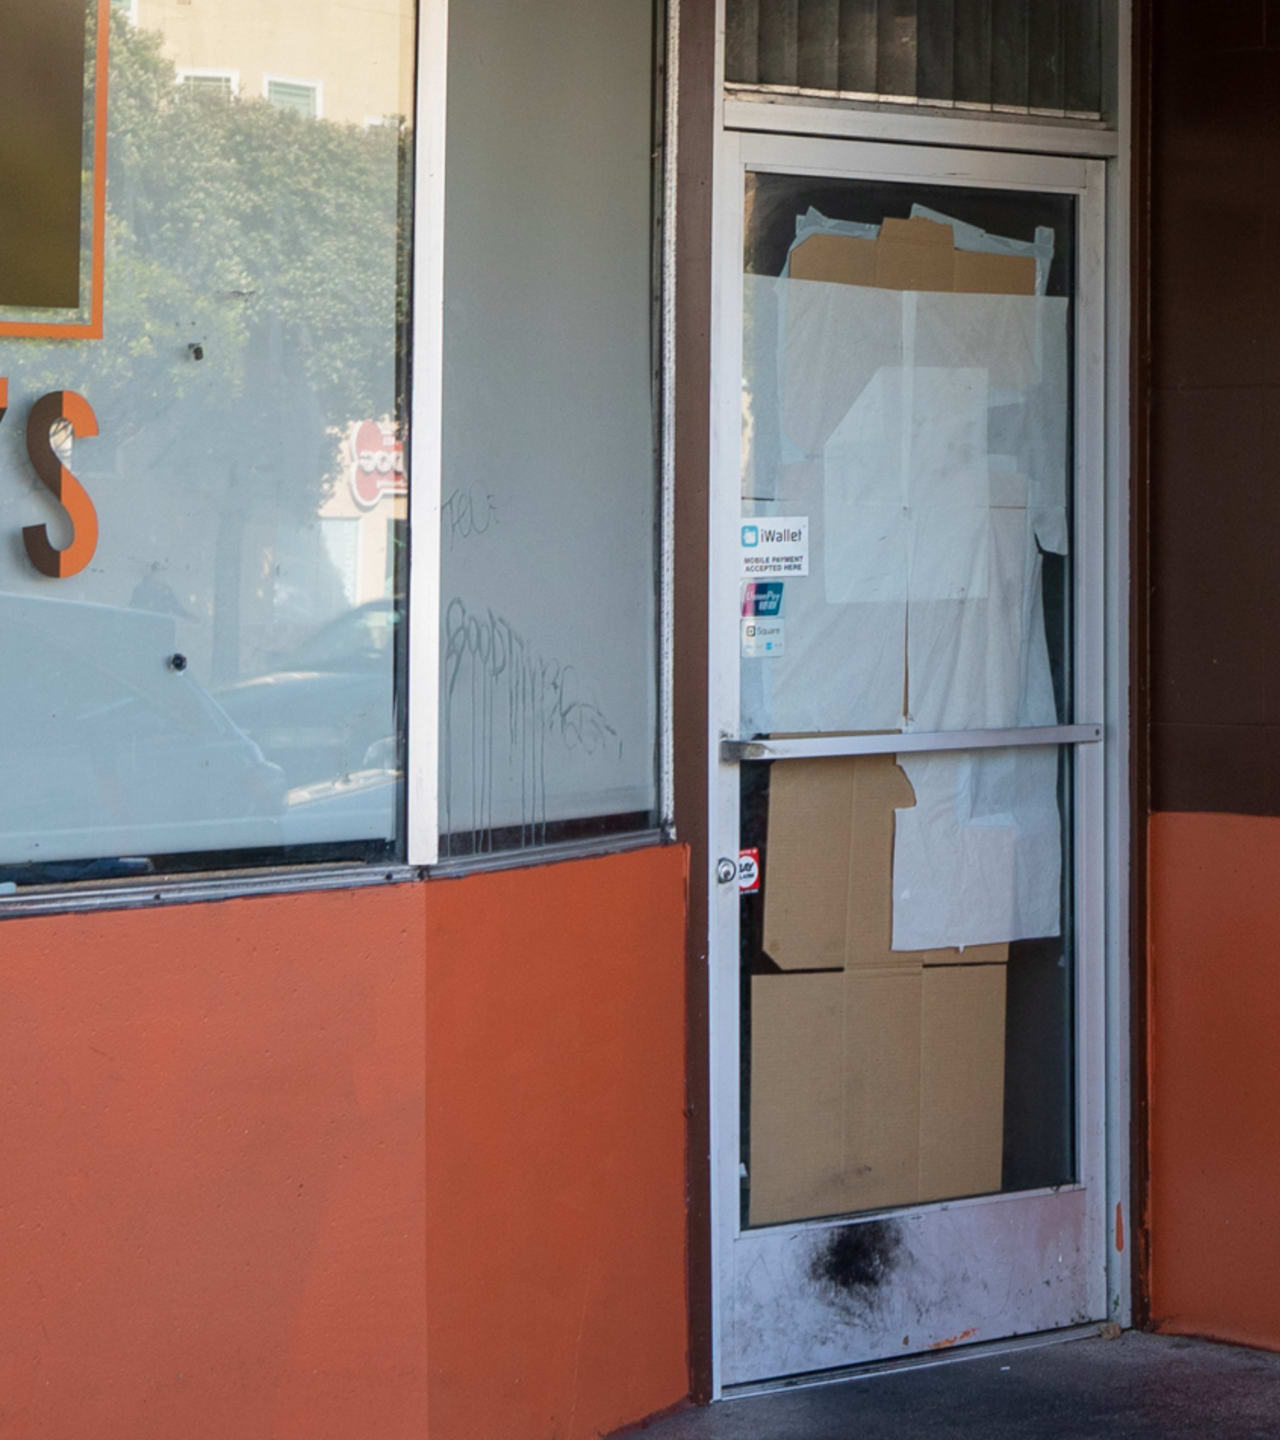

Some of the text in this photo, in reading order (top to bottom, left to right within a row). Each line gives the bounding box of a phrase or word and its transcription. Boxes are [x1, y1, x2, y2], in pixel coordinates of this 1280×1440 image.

[760, 528, 802, 543] iWallet
[745, 563, 802, 573] ACCEPTED HERE
